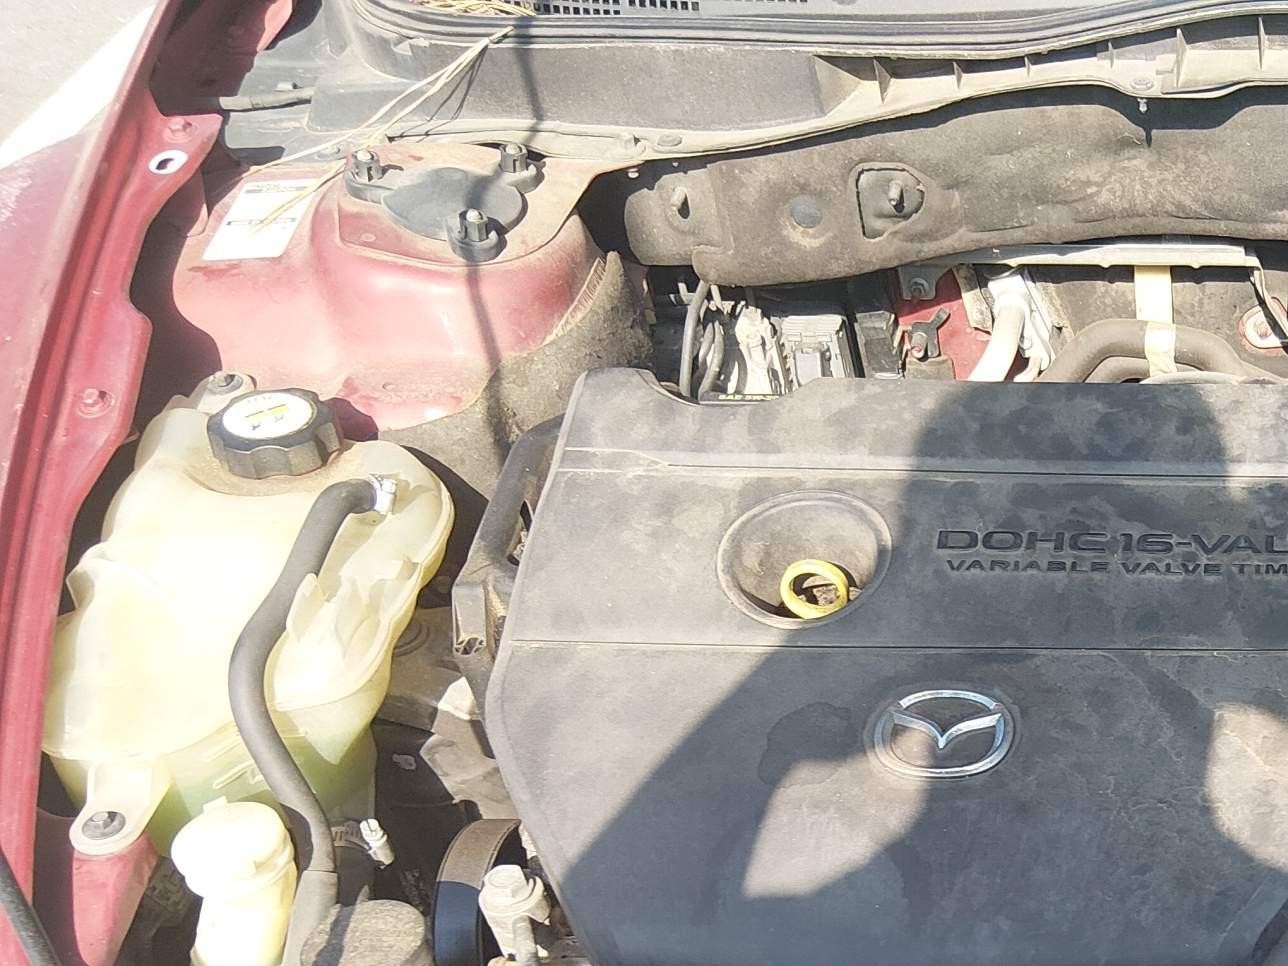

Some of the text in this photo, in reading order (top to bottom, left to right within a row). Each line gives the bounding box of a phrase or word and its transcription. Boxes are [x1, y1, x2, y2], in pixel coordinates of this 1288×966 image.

[936, 529, 1109, 554] DOHC
[946, 558, 1111, 575] VARIABLE
[1119, 561, 1223, 577] VALVE
